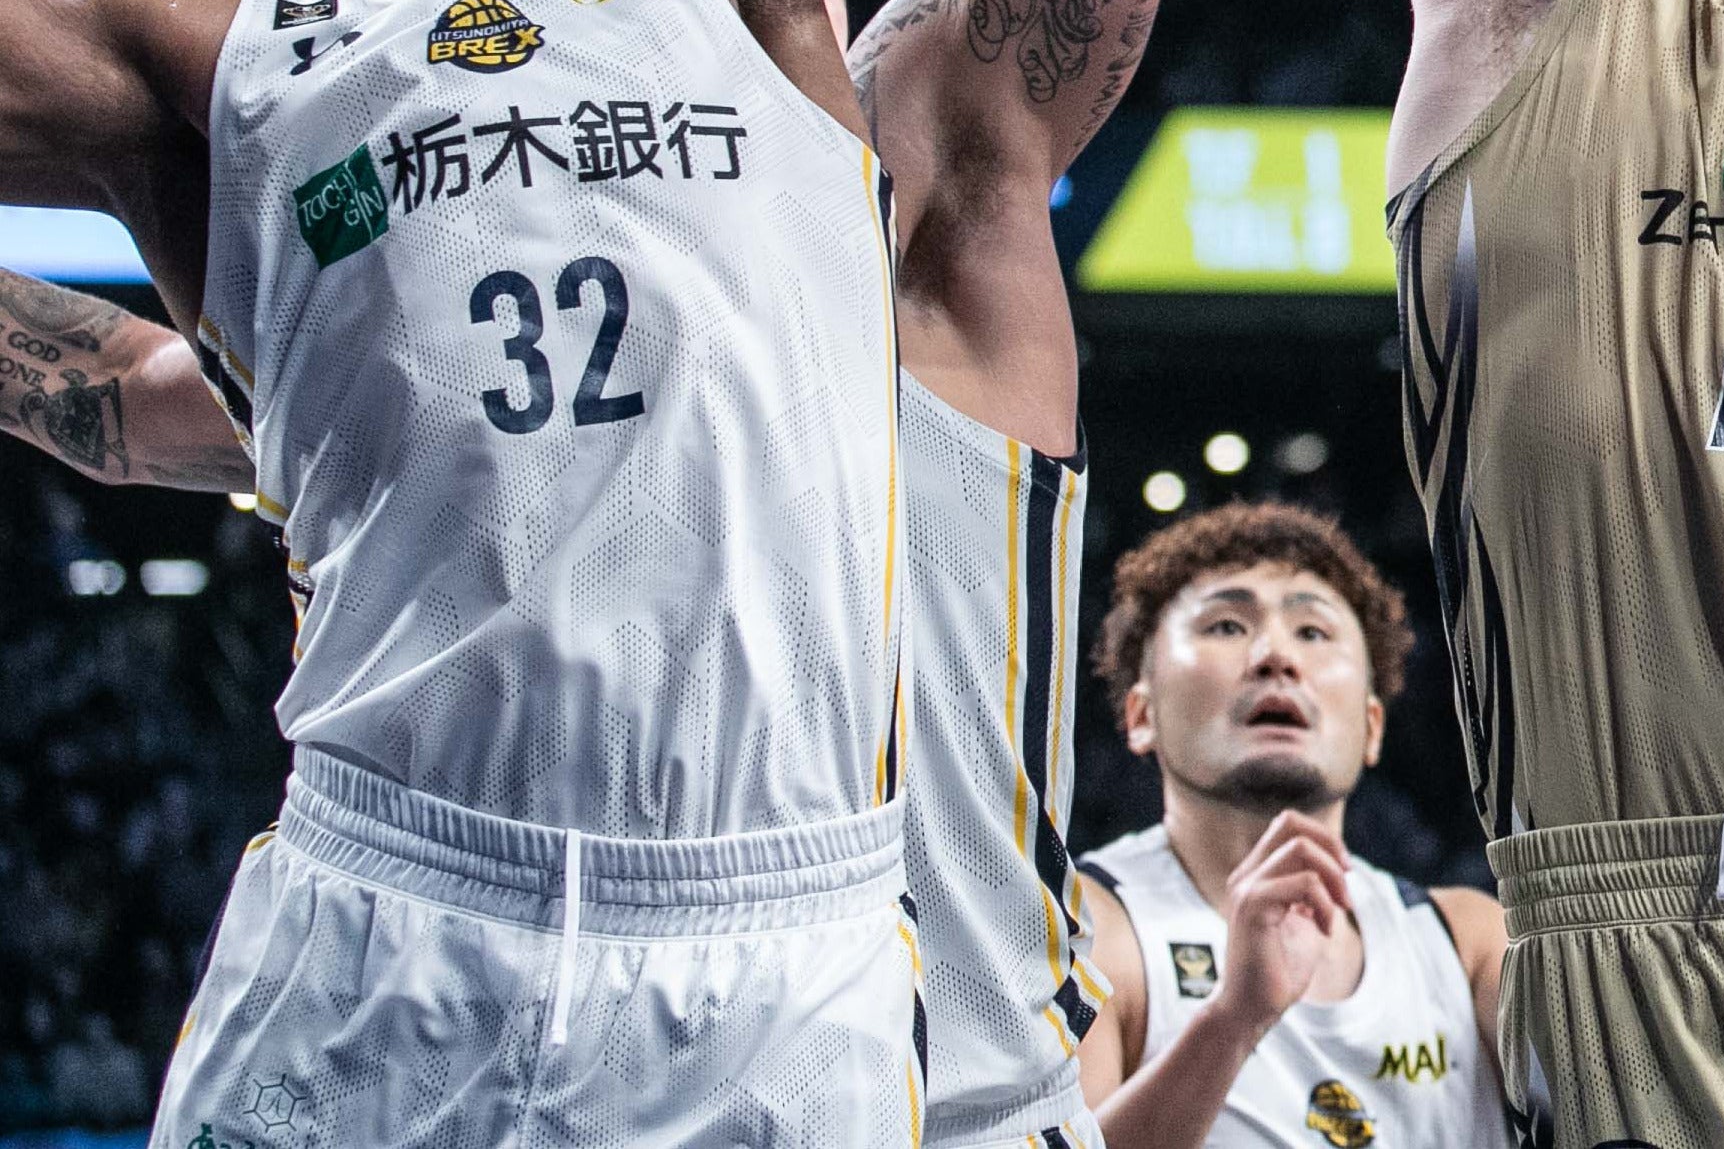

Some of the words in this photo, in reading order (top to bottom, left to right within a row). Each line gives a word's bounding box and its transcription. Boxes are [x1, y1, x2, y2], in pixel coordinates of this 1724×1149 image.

[430, 27, 543, 62] BREX
[431, 18, 531, 42] UTSUNOMIYA
[382, 99, 748, 215] 栃木銀行
[8, 331, 61, 363] GOD
[469, 256, 645, 435] 32
